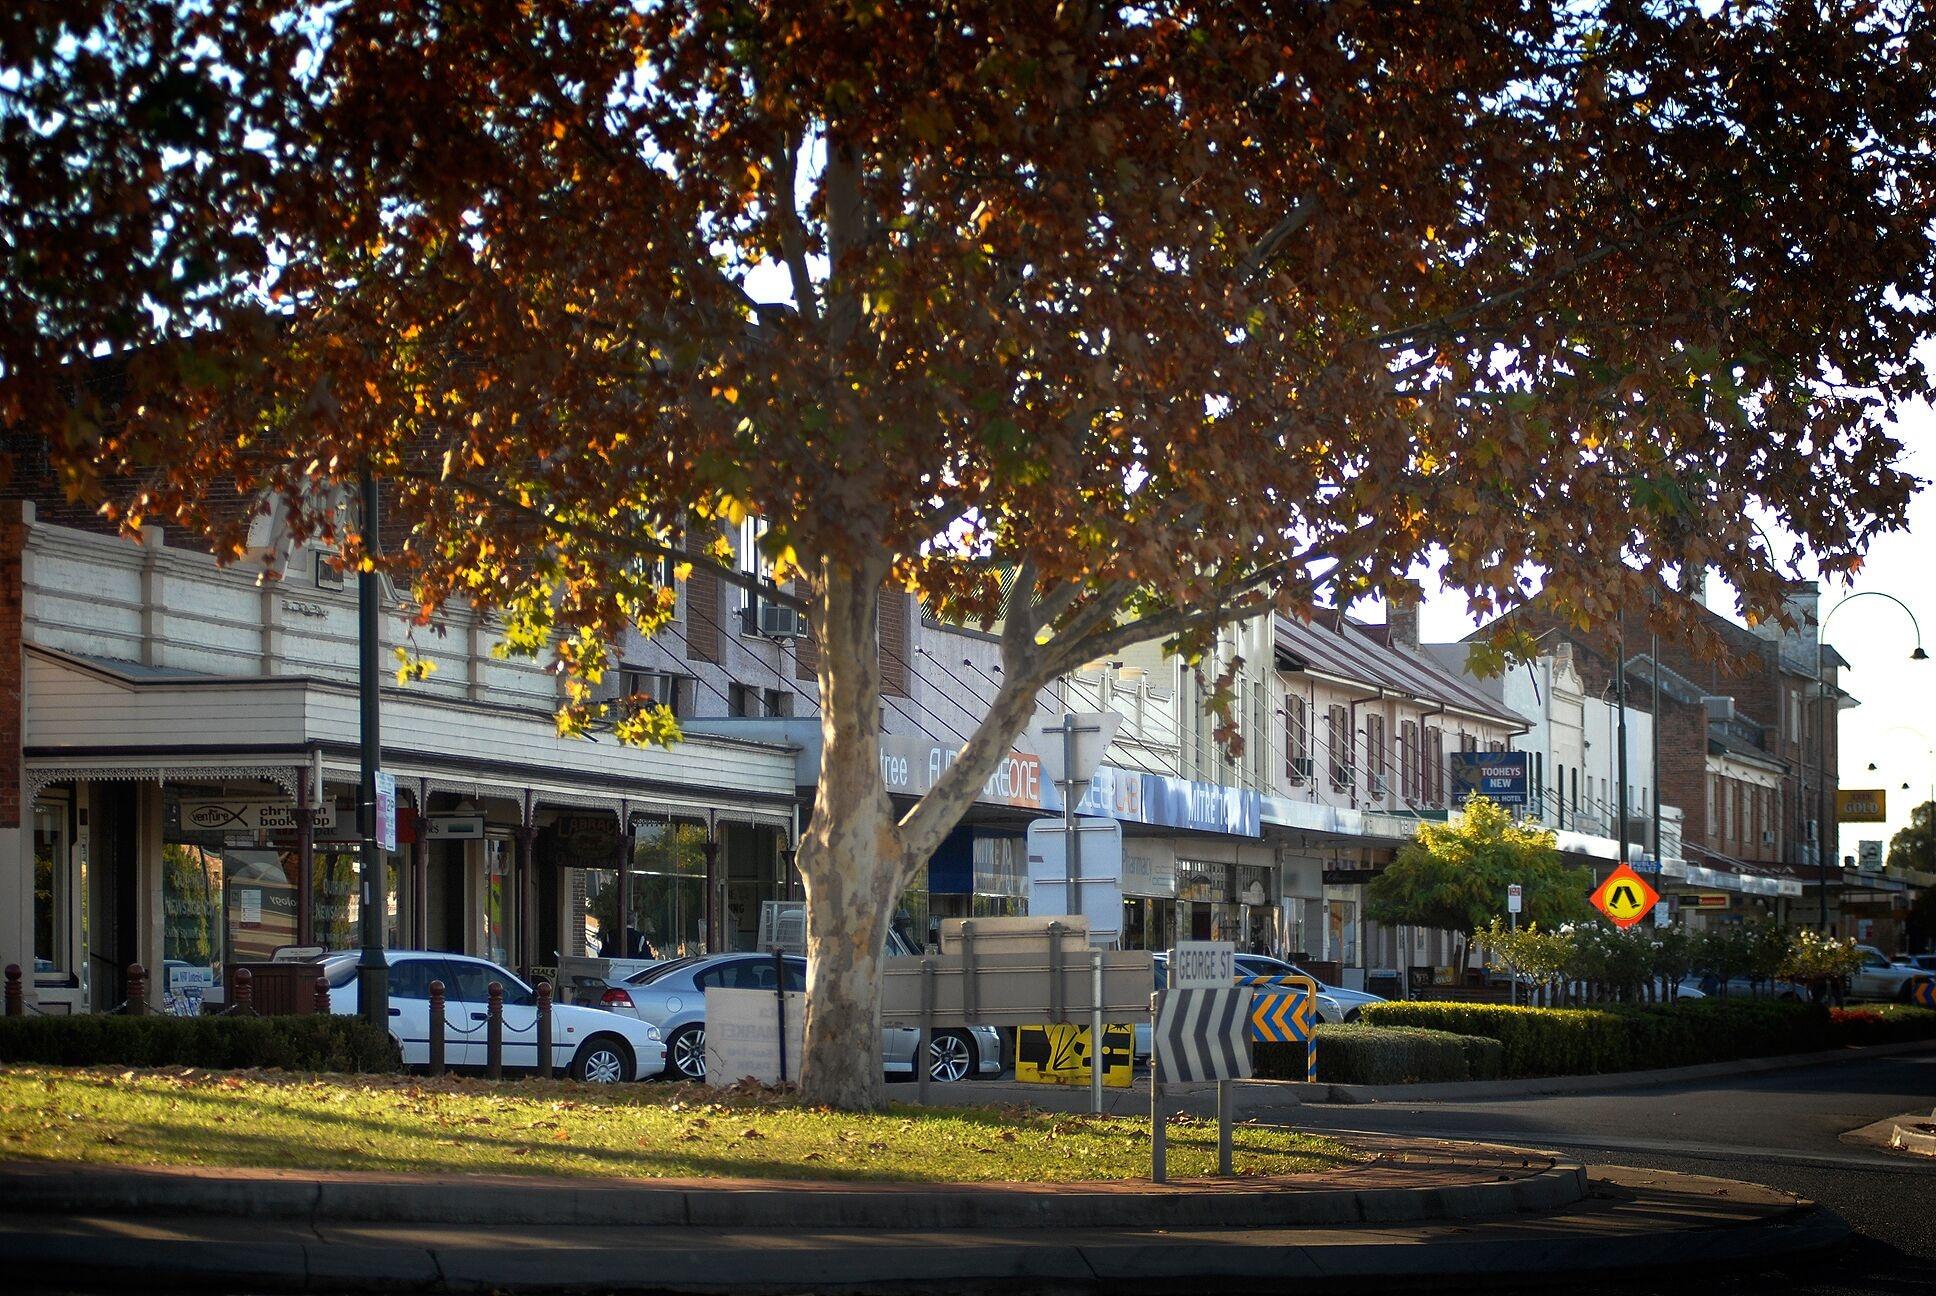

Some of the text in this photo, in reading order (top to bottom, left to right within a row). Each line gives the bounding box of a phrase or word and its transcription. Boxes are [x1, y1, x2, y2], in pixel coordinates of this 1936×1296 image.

[1481, 767, 1521, 776] TOOHEYS
[1490, 779, 1512, 788] NEW
[259, 805, 327, 817] chrin
[1188, 789, 1216, 824] MITRE
[1844, 802, 1879, 814] GOLD
[259, 816, 330, 827] bookop
[1121, 847, 1152, 881] Pharmacy
[1179, 950, 1232, 980] GEORGE ST
